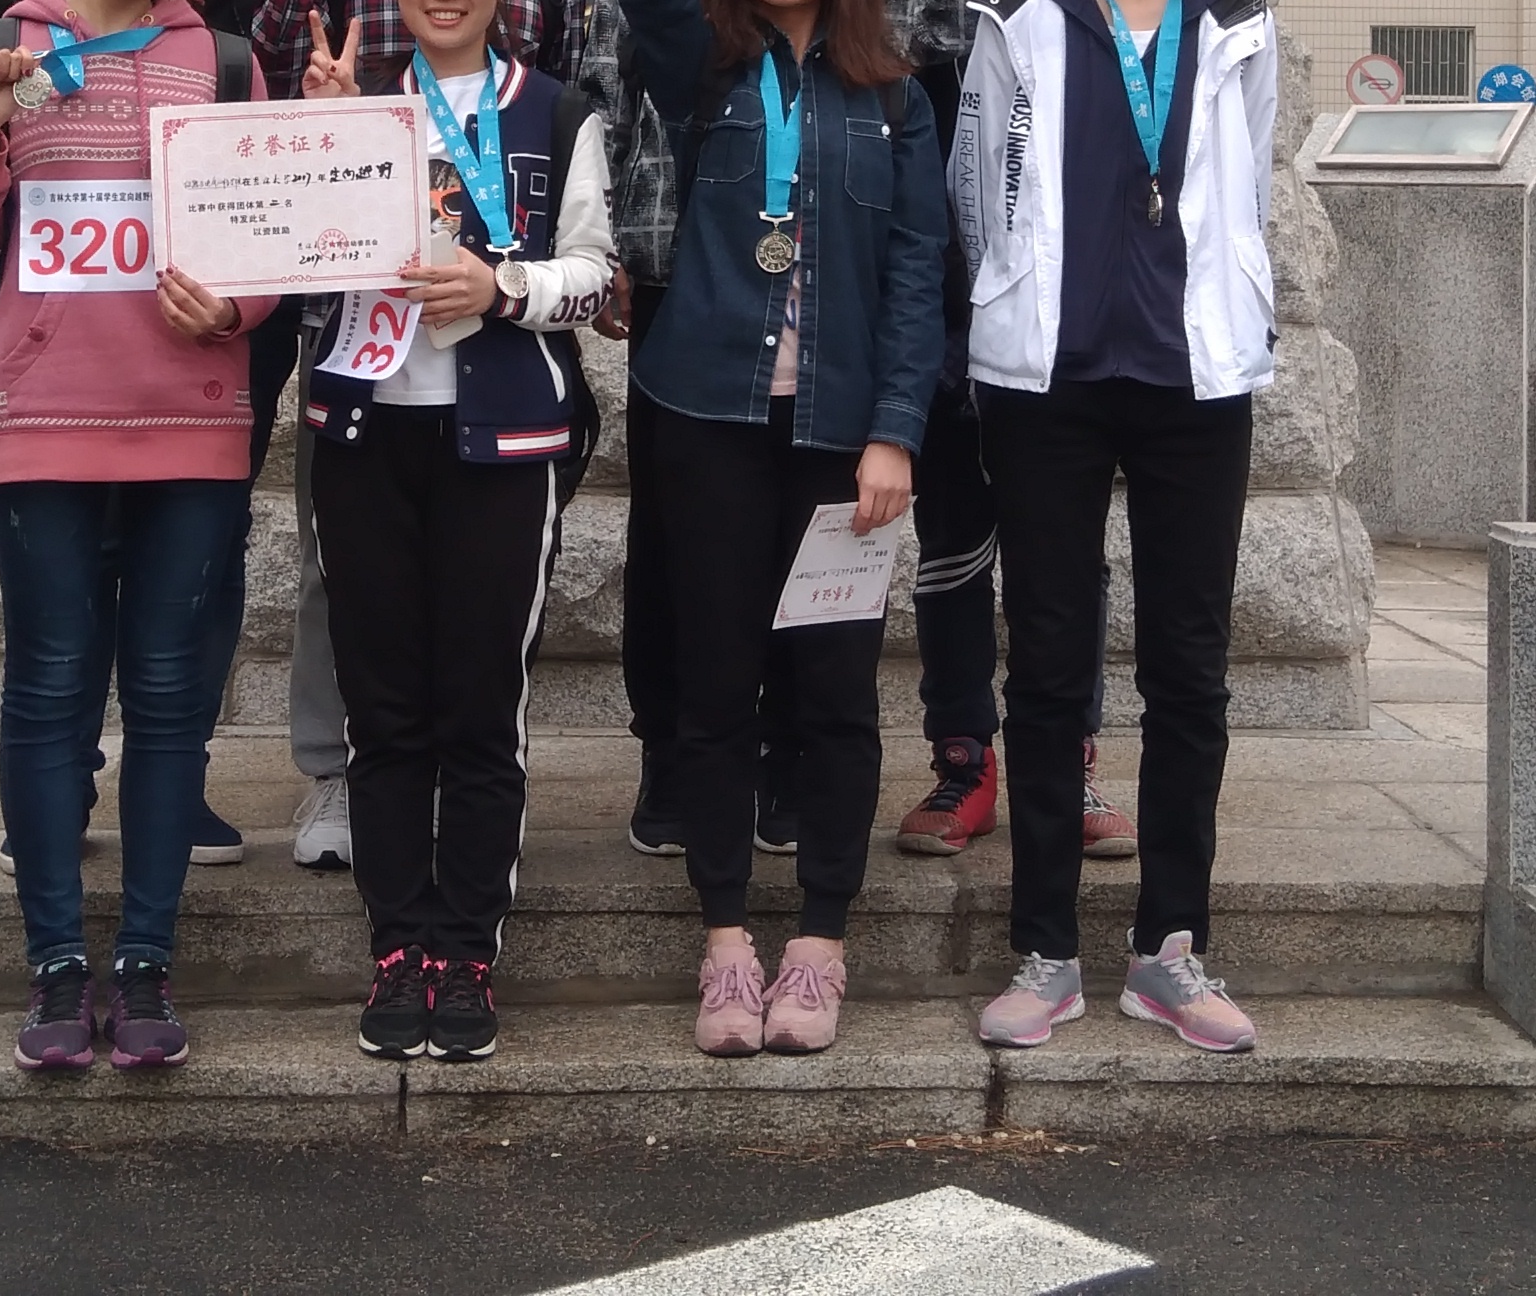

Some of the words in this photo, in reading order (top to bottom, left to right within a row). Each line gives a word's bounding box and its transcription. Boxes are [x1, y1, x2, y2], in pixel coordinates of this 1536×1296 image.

[1479, 71, 1536, 102] 南湖会馆
[235, 132, 336, 158] 荣誉证书
[959, 129, 975, 188] BREAK
[49, 192, 153, 203] 吉林大学第十届学生定向越野
[961, 194, 978, 229] THE
[28, 217, 155, 276] 320
[964, 234, 983, 288] BON
[351, 288, 411, 374] 32
